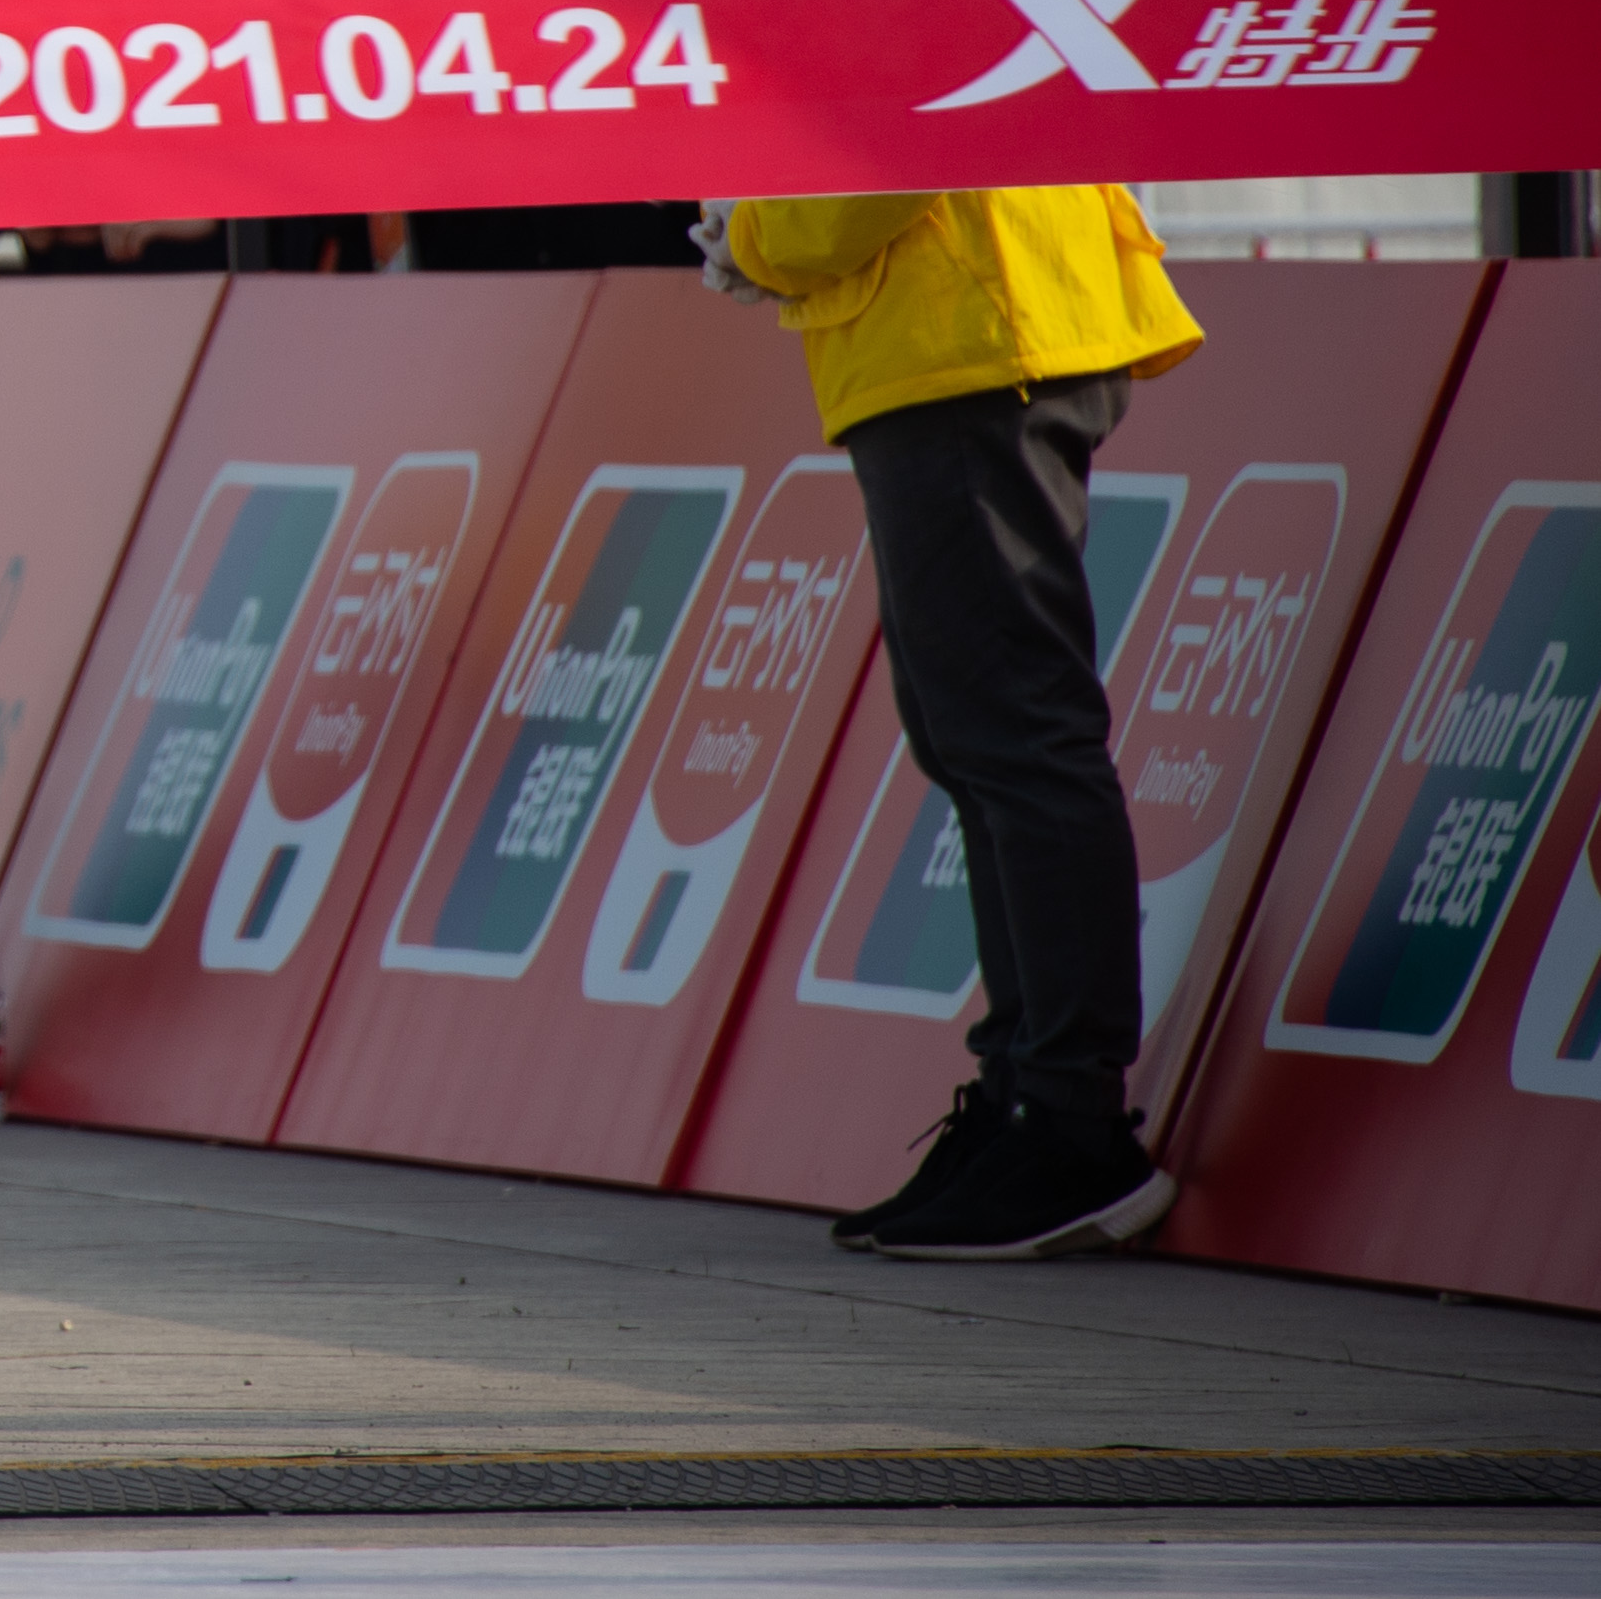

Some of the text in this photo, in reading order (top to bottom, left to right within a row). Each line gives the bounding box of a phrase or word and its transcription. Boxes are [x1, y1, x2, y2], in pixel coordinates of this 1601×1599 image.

[501, 602, 657, 768] UnionPay
[700, 554, 848, 694] 云闪付
[1149, 569, 1313, 719] 云闪付
[682, 718, 764, 790] UnionPay
[1132, 745, 1224, 822] UnionPay
[1401, 637, 1591, 830] UnionPay
[1397, 796, 1520, 929] 银联
